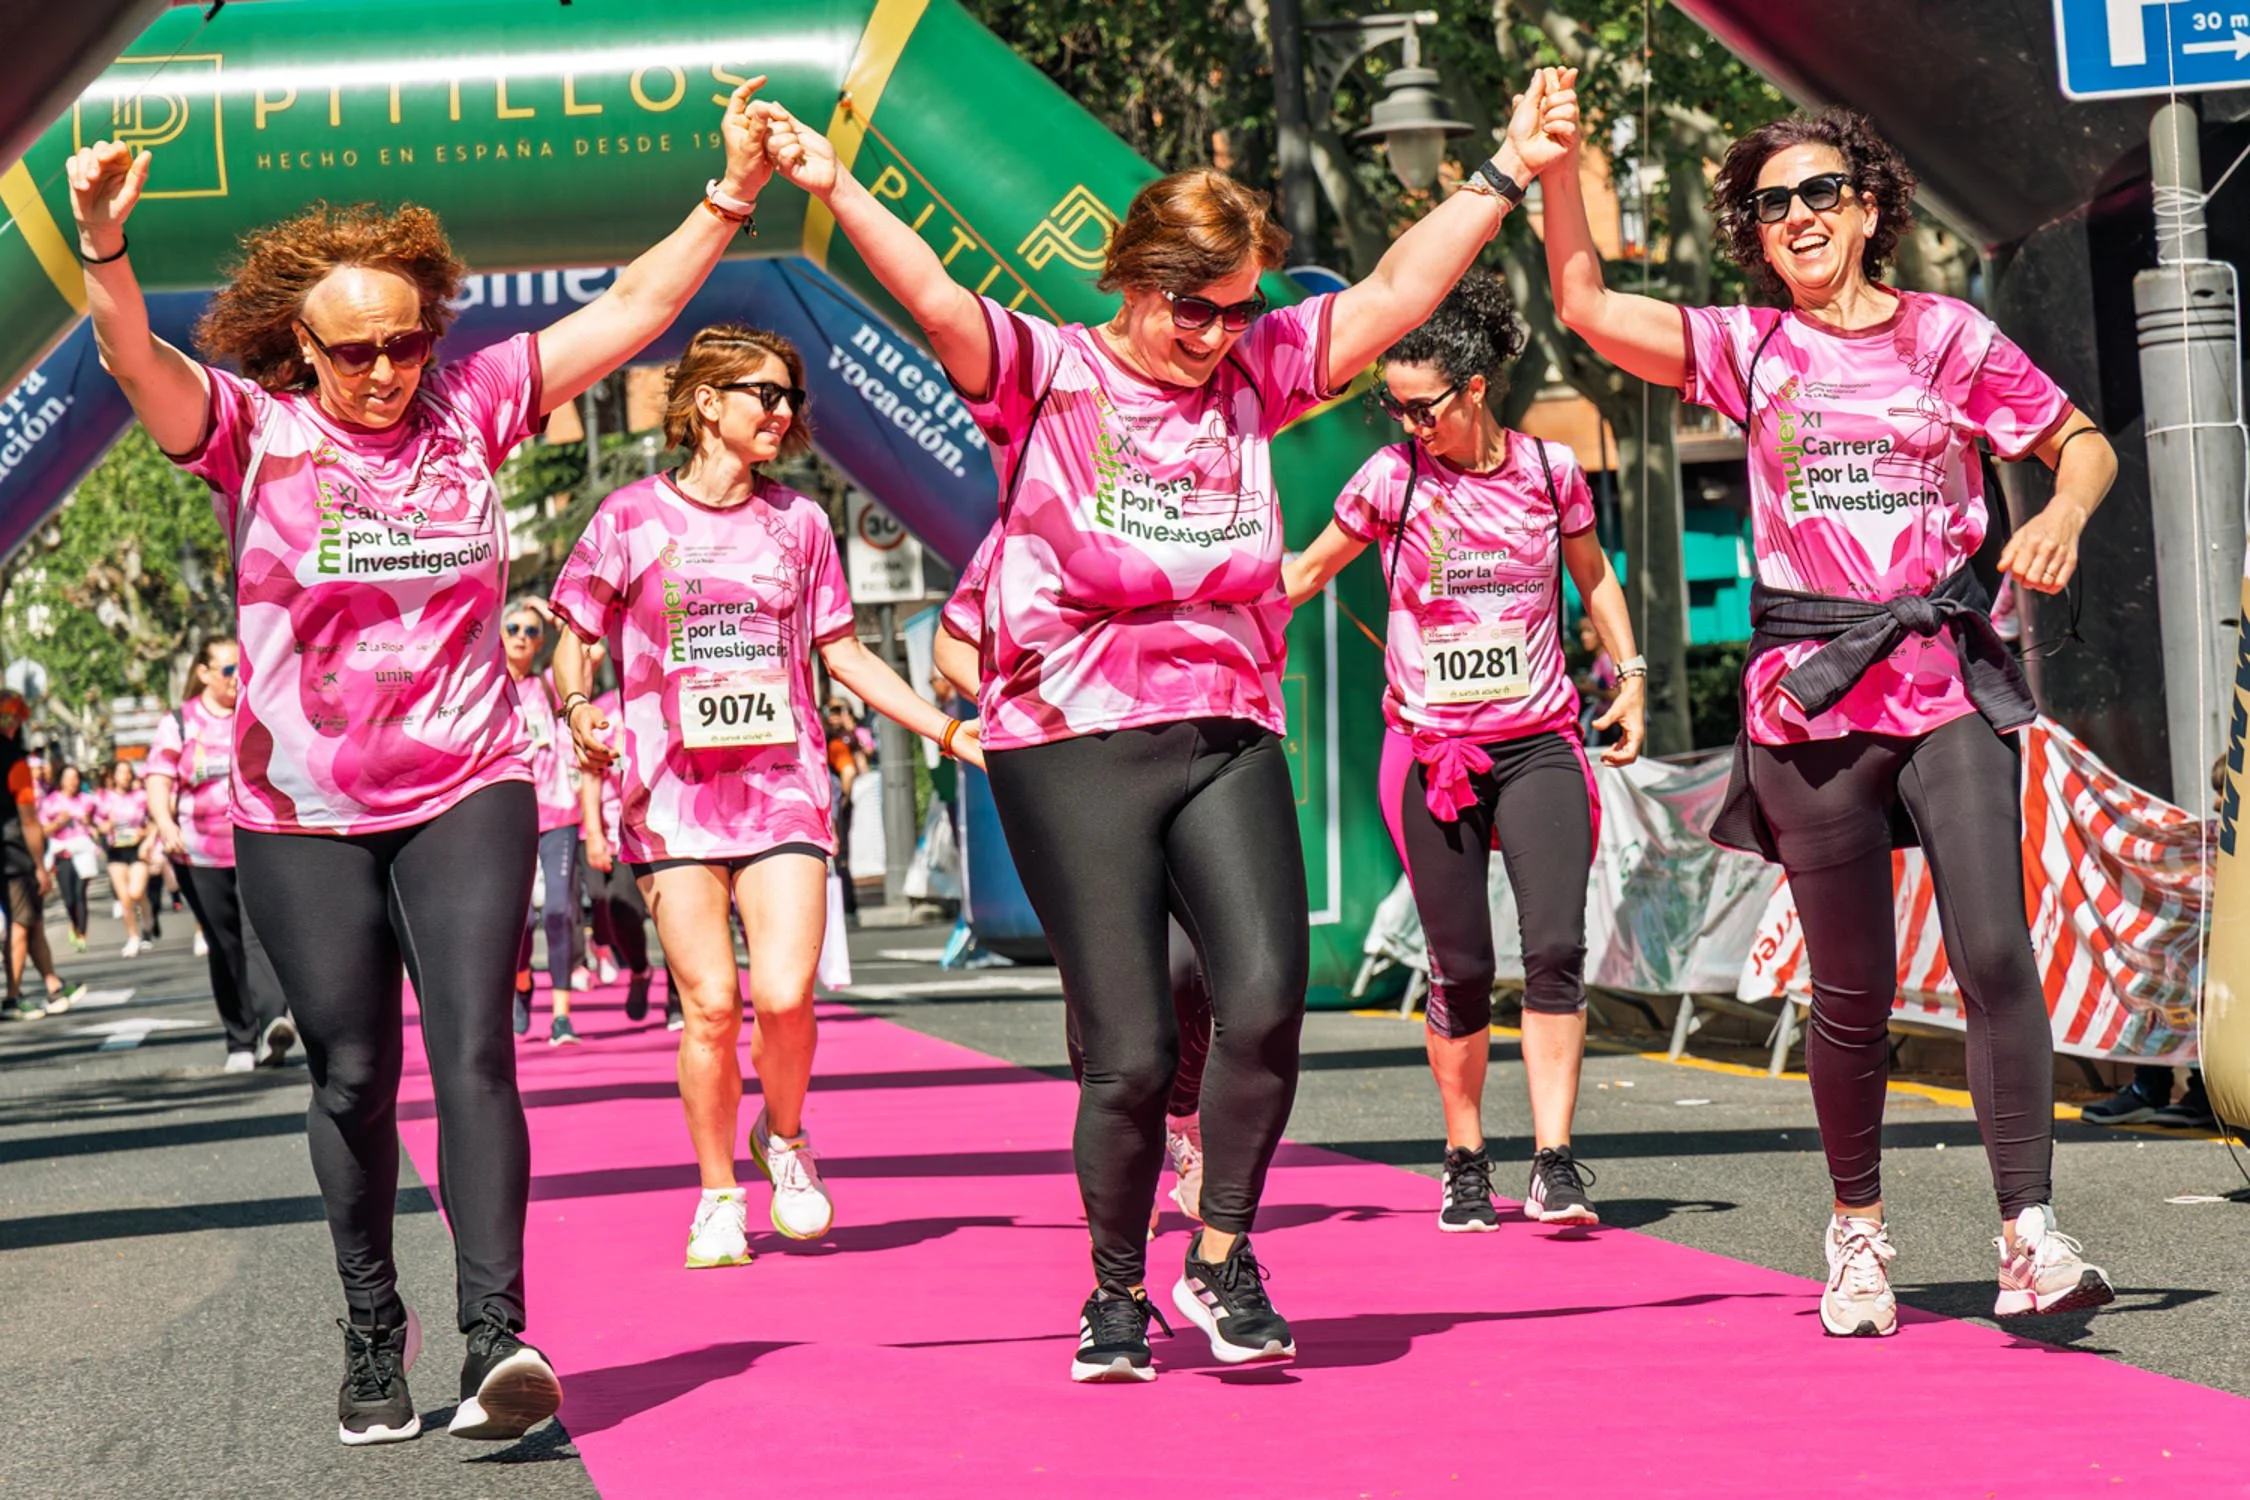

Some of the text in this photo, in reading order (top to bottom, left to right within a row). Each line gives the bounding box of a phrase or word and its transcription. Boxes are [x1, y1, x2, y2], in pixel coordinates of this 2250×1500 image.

[2192, 11, 2249, 31] 30 m
[257, 131, 721, 169] HECHO EN ESPAÑA DESDE 19
[851, 323, 988, 451] nuestra
[828, 345, 966, 478] vocación.
[1800, 411, 1822, 428] XI
[0, 396, 75, 484] ción.
[1802, 436, 1891, 456] Carrera
[1776, 409, 1809, 512] mujer
[1091, 422, 1124, 528] muje
[1807, 463, 1869, 488] por la
[337, 482, 358, 503] XI
[1121, 488, 1155, 512] por
[1811, 485, 1939, 514] Investigacin
[347, 527, 412, 549] por la
[1120, 513, 1263, 548] Investigación
[1448, 528, 1463, 542] XI
[347, 541, 493, 574] Investigación
[1425, 525, 1449, 596] mujer
[1447, 547, 1507, 561] Carrera
[1447, 566, 1491, 582] por la
[684, 579, 702, 595] XI
[1447, 580, 1544, 597] Investigación
[662, 578, 688, 662] mujer
[686, 600, 755, 616] Carrera
[688, 621, 736, 642] por la
[1433, 645, 1518, 681] 10281
[698, 692, 776, 728] 9074
